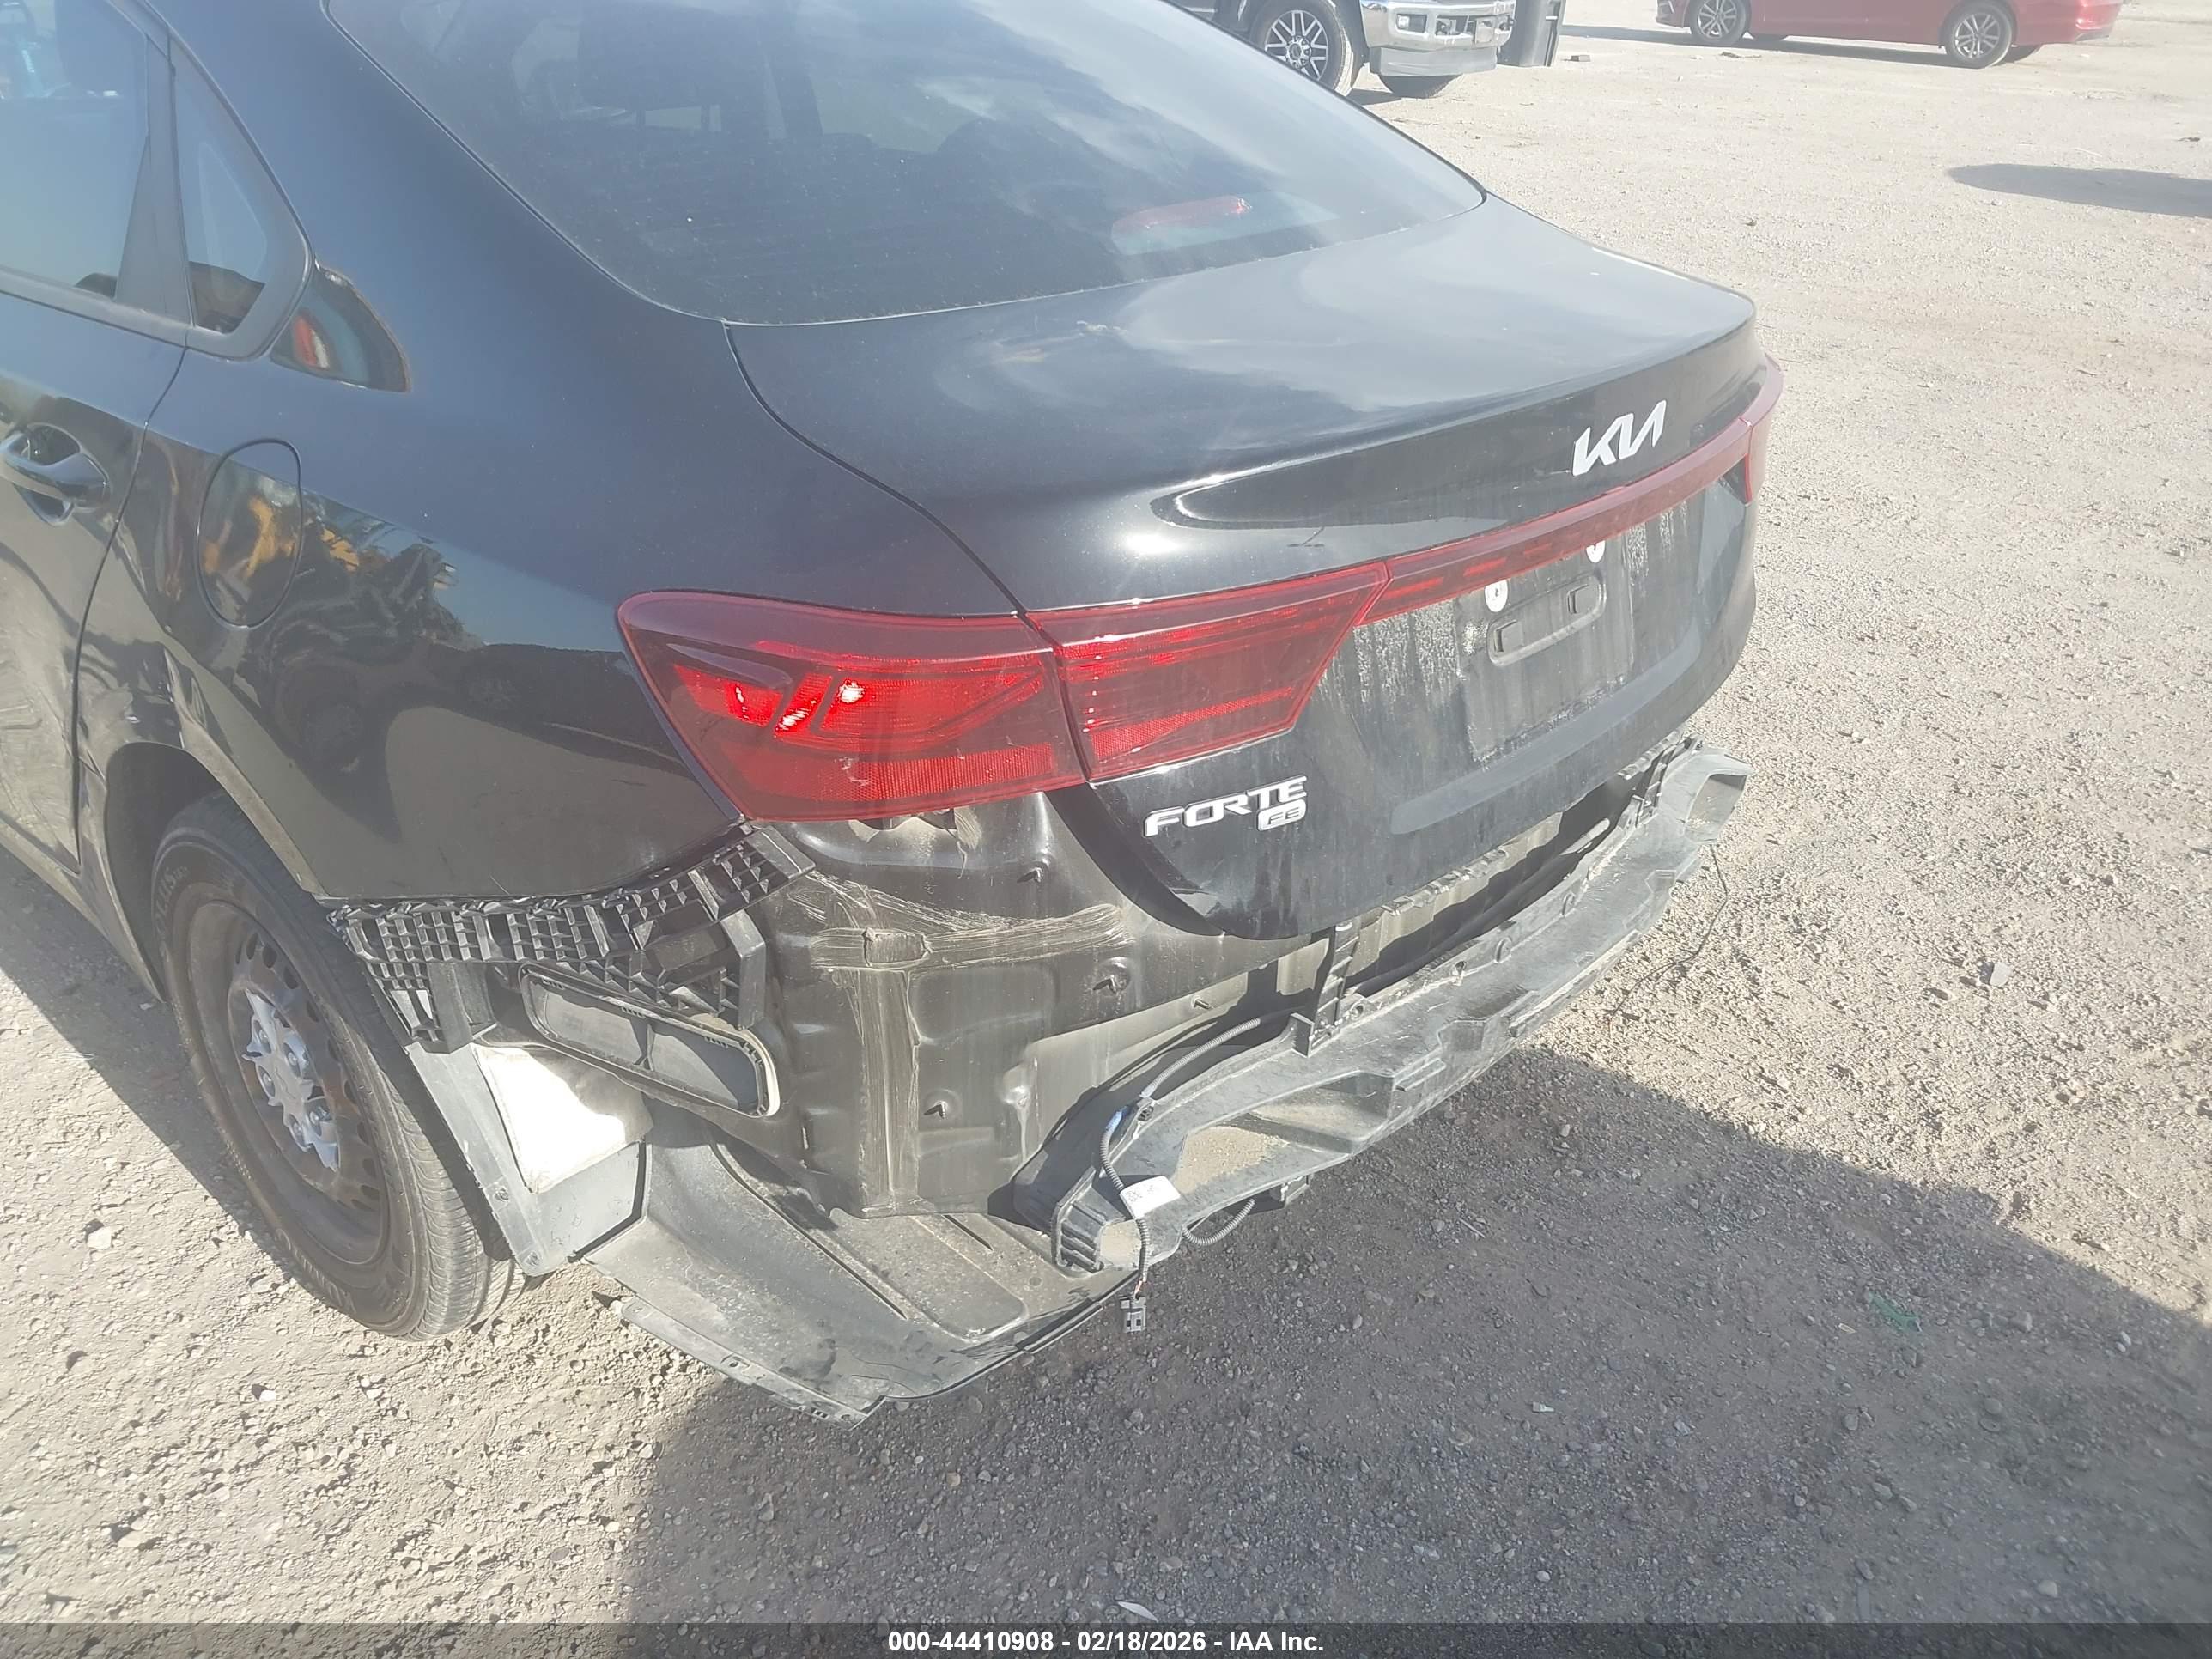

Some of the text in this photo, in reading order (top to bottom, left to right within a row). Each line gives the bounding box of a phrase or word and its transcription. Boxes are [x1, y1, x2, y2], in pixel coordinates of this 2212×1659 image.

[1572, 400, 1667, 477] KIA
[1144, 775, 1307, 837] FORTE
[1262, 802, 1304, 829] FE
